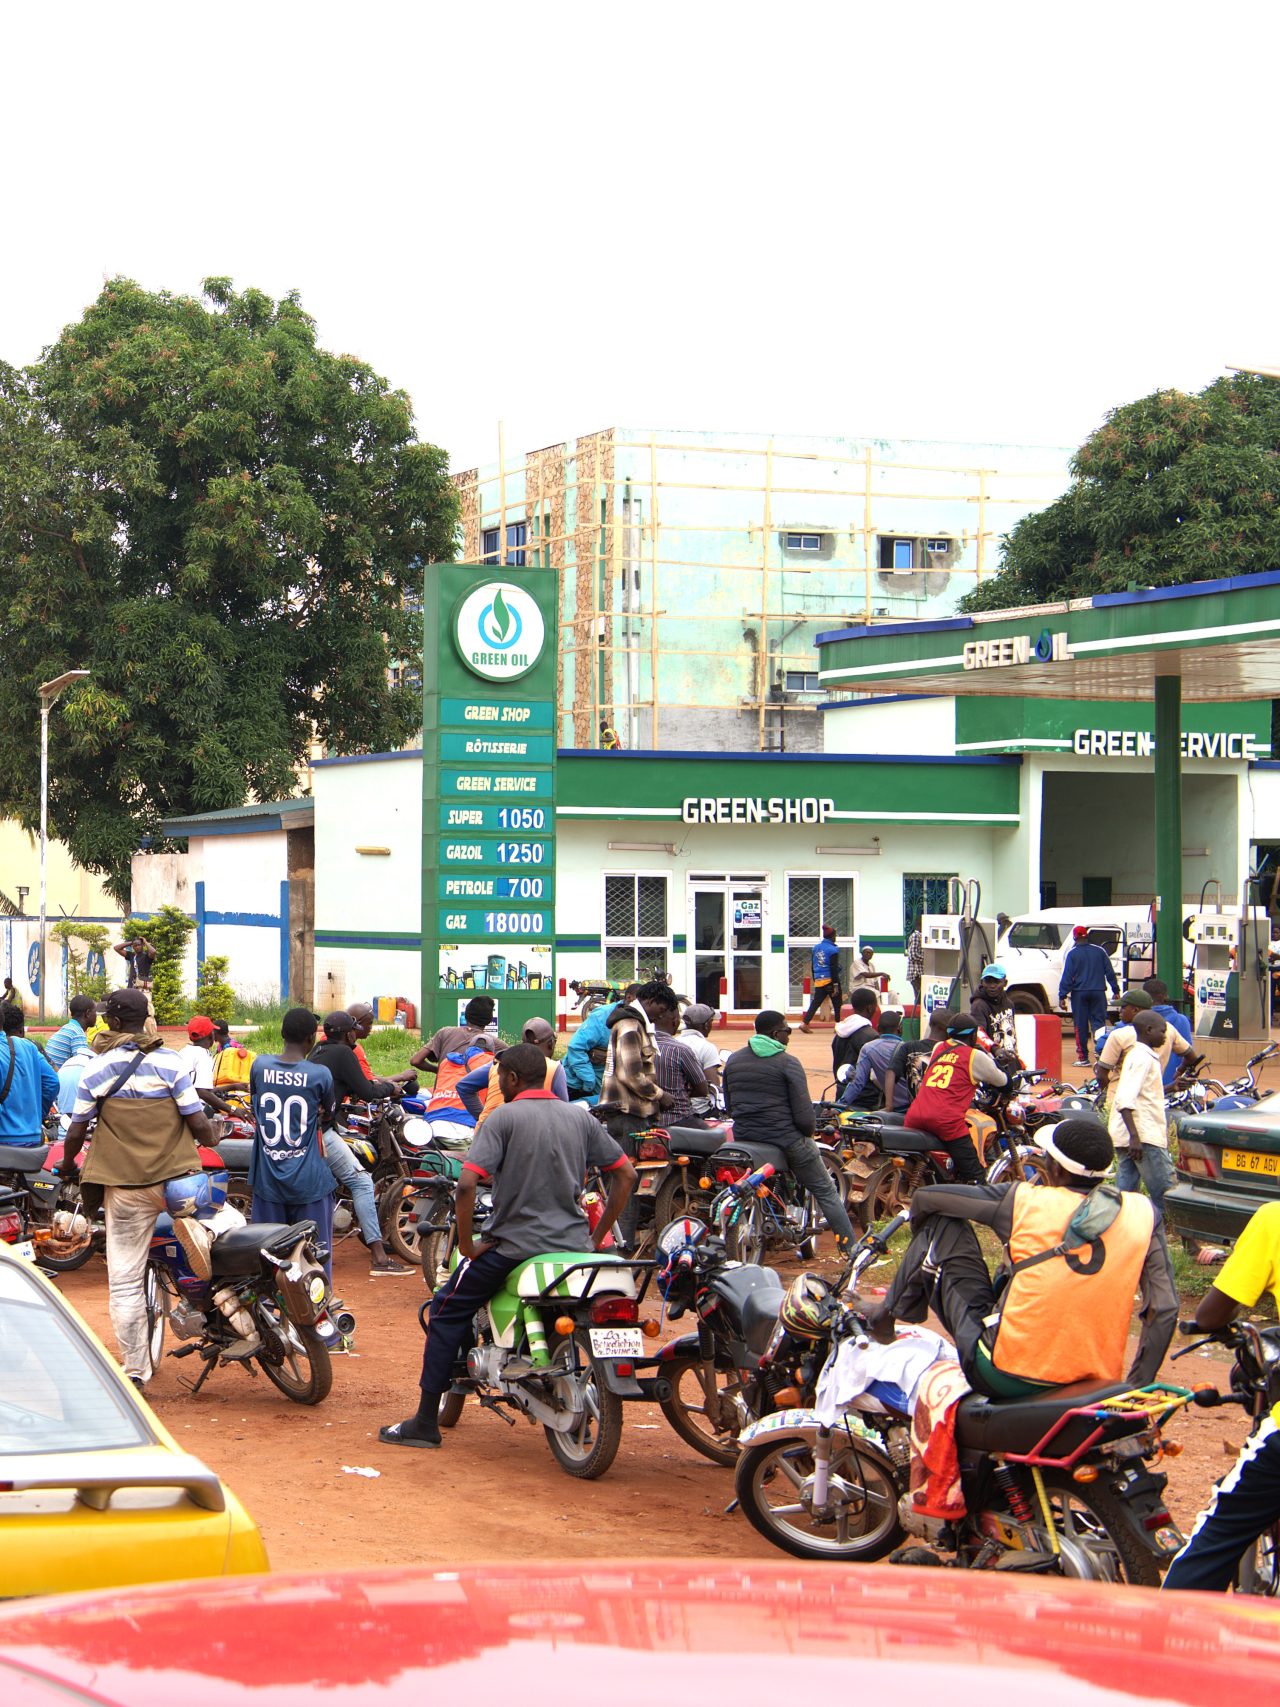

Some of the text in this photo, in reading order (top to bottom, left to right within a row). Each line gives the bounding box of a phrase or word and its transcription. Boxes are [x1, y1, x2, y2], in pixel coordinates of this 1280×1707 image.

[472, 652, 529, 667] GREEN OIL
[963, 635, 1030, 670] GREEN
[464, 705, 531, 722] GREEN SHOP
[465, 738, 527, 755] RÔTISSERIE
[1074, 729, 1257, 759] GREEN ERVICE
[456, 776, 537, 792] GREEN SERVICE
[448, 808, 545, 829] SUPER 1050
[682, 797, 836, 824] GREEN SHOP
[446, 843, 543, 863] GAZOIL 1250
[445, 878, 543, 898] PETROLE 700
[741, 901, 760, 910] Gaz
[445, 912, 543, 933] GAZ 18000
[933, 985, 948, 996] Gaz
[1207, 978, 1225, 988] Gaz
[263, 1068, 308, 1088] MESSI
[925, 1065, 954, 1089] 23
[260, 1092, 308, 1147] 30
[1236, 1154, 1278, 1173] BG 67 AGV
